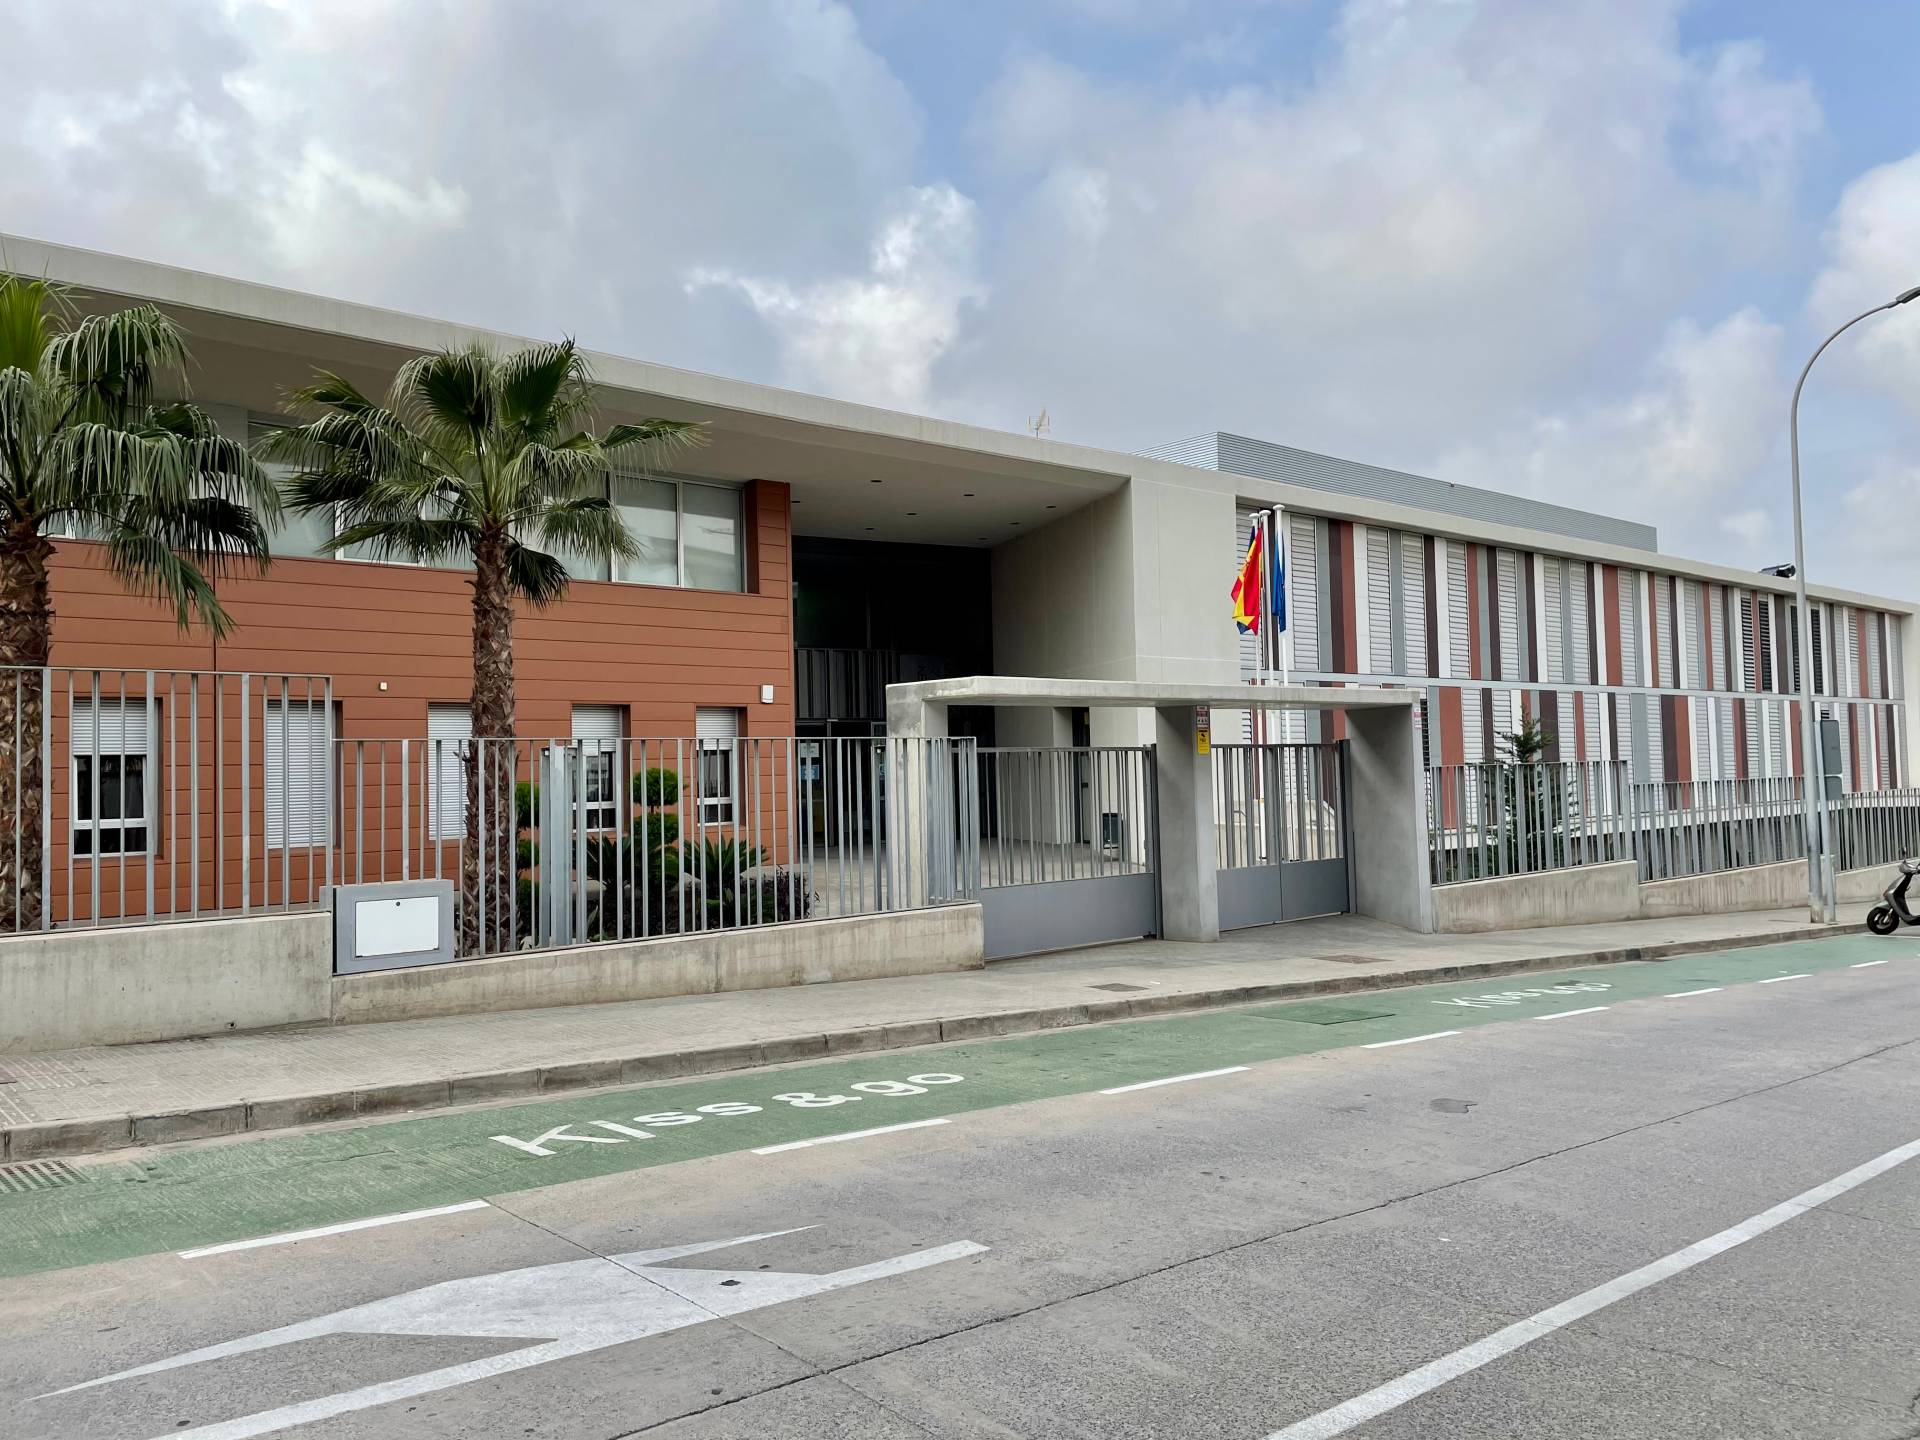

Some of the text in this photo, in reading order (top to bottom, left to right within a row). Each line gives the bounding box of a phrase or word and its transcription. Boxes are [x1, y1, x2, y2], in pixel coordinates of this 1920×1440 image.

[488, 1073, 965, 1156] Kiss & go
